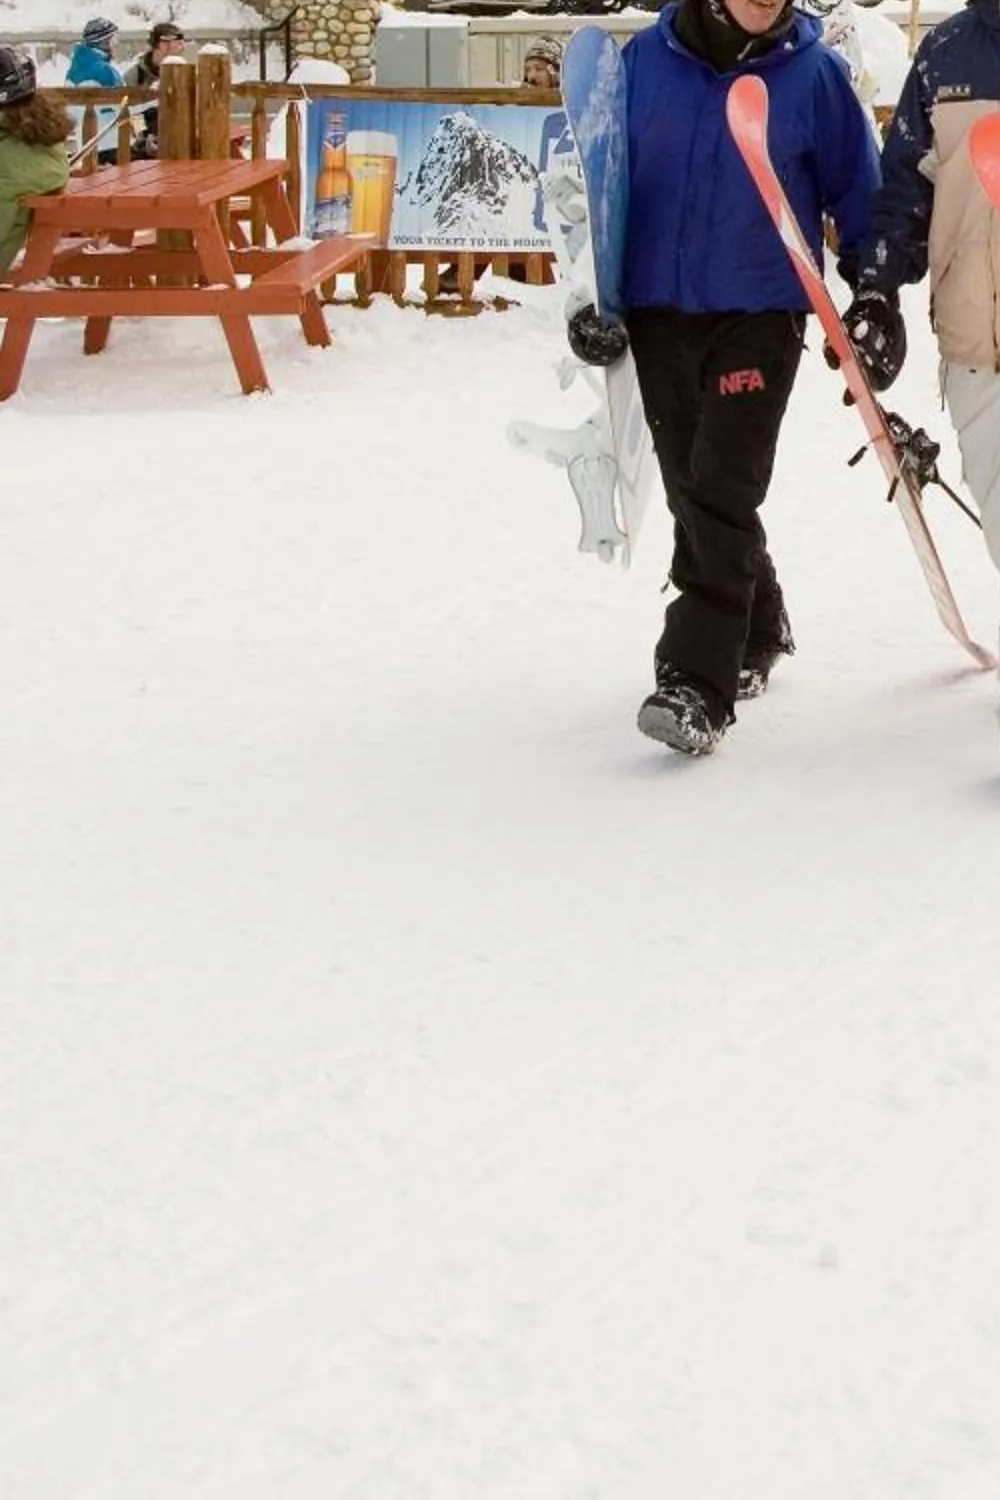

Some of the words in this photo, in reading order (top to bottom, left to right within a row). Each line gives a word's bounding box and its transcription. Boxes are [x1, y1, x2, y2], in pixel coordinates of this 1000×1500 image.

[394, 235, 423, 245] YOUR
[427, 235, 466, 246] TICKET
[470, 237, 485, 246] TO
[487, 237, 510, 247] THE
[719, 367, 766, 396] NFA
